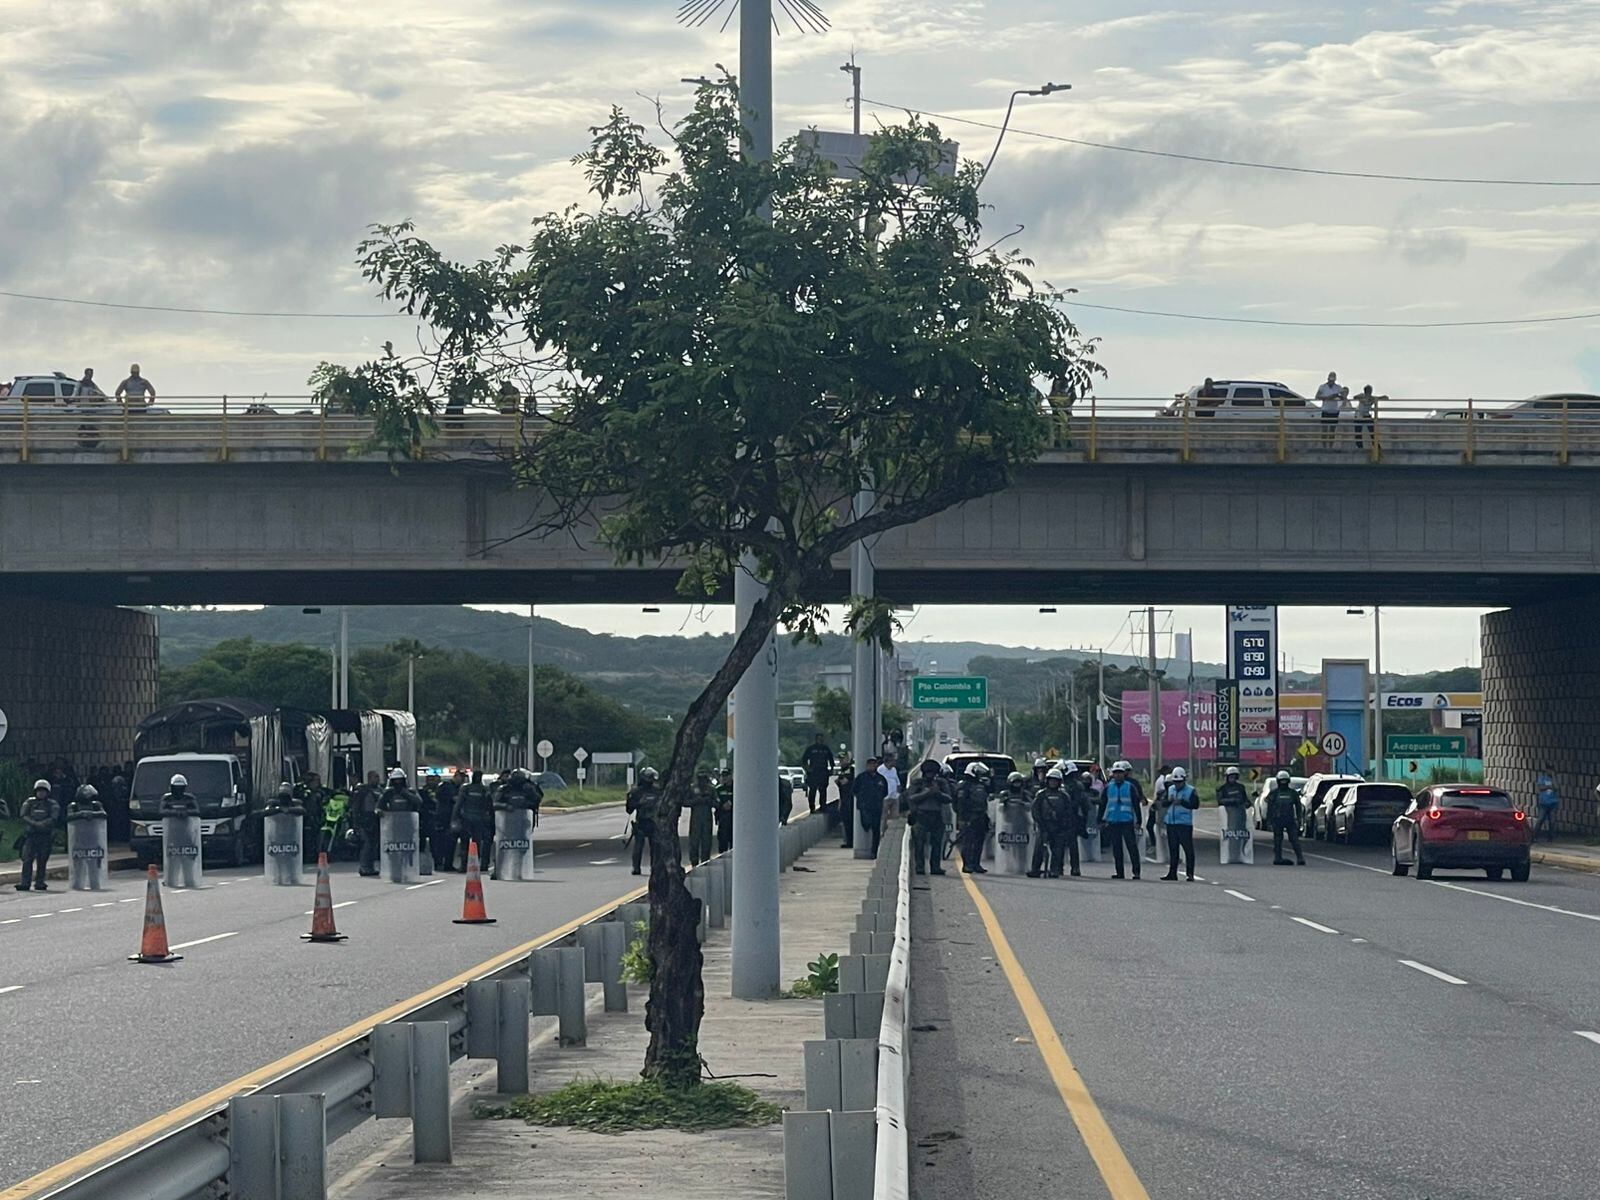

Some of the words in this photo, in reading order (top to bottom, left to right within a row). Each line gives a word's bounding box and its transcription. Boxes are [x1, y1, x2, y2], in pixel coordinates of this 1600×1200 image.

[918, 696, 958, 704] Cartagena
[1387, 696, 1423, 707] Ecos
[1240, 722, 1267, 732] OXXO
[1325, 738, 1341, 751] 40
[1393, 742, 1442, 751] Aeropuerto
[999, 834, 1028, 842] POLICIA
[385, 842, 415, 851] POLICIA
[500, 840, 529, 848] POLICIA
[73, 849, 104, 858] POLICIA
[167, 847, 197, 855] POLICIA
